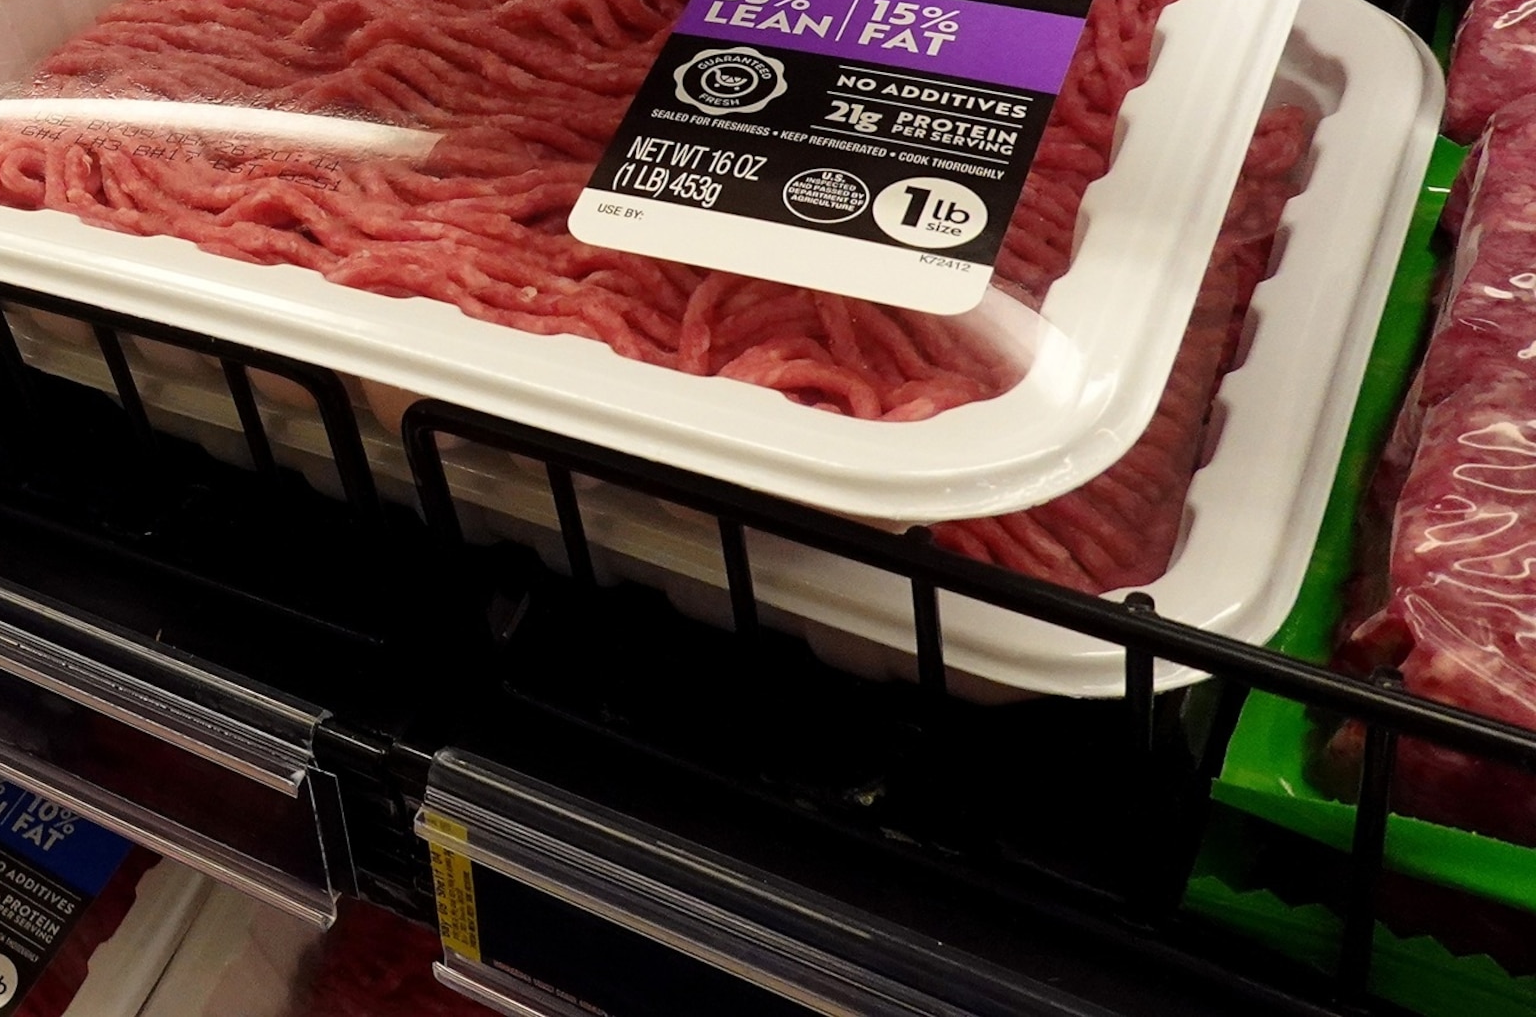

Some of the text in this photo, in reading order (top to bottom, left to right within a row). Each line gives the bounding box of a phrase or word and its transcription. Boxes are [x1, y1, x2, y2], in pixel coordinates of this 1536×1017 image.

[703, 0, 956, 57] LEAN FAT
[697, 54, 773, 81] GUARANTEED
[698, 92, 741, 107] FRESH
[836, 74, 1028, 119] NO ADDITIVES
[34, 110, 76, 128] USE
[824, 100, 1018, 146] 21g PROTEIN
[651, 108, 1006, 181] SEALED FOR FRESHNESS KEEP REFRIGERATED COOK THOROUGHLY
[891, 124, 1014, 156] PER SERVING
[626, 135, 768, 181] NET WT 16 OZ
[612, 162, 724, 208] (1 LB) 453g
[792, 181, 865, 200] AND PASSED BY
[805, 177, 857, 192] INSPECTED
[821, 171, 846, 183] U.S.
[597, 202, 645, 221] USE BY:
[788, 186, 864, 206] DEPARTMENT OF
[790, 194, 856, 212] AGRICULTURE
[900, 185, 971, 228] 1 lb
[925, 220, 963, 237] size
[919, 254, 972, 273] K72412
[11, 819, 66, 852] FAT
[8, 861, 75, 916] ADDITIVES
[2, 894, 62, 937] PROTEIN
[14, 914, 54, 945] SERVING
